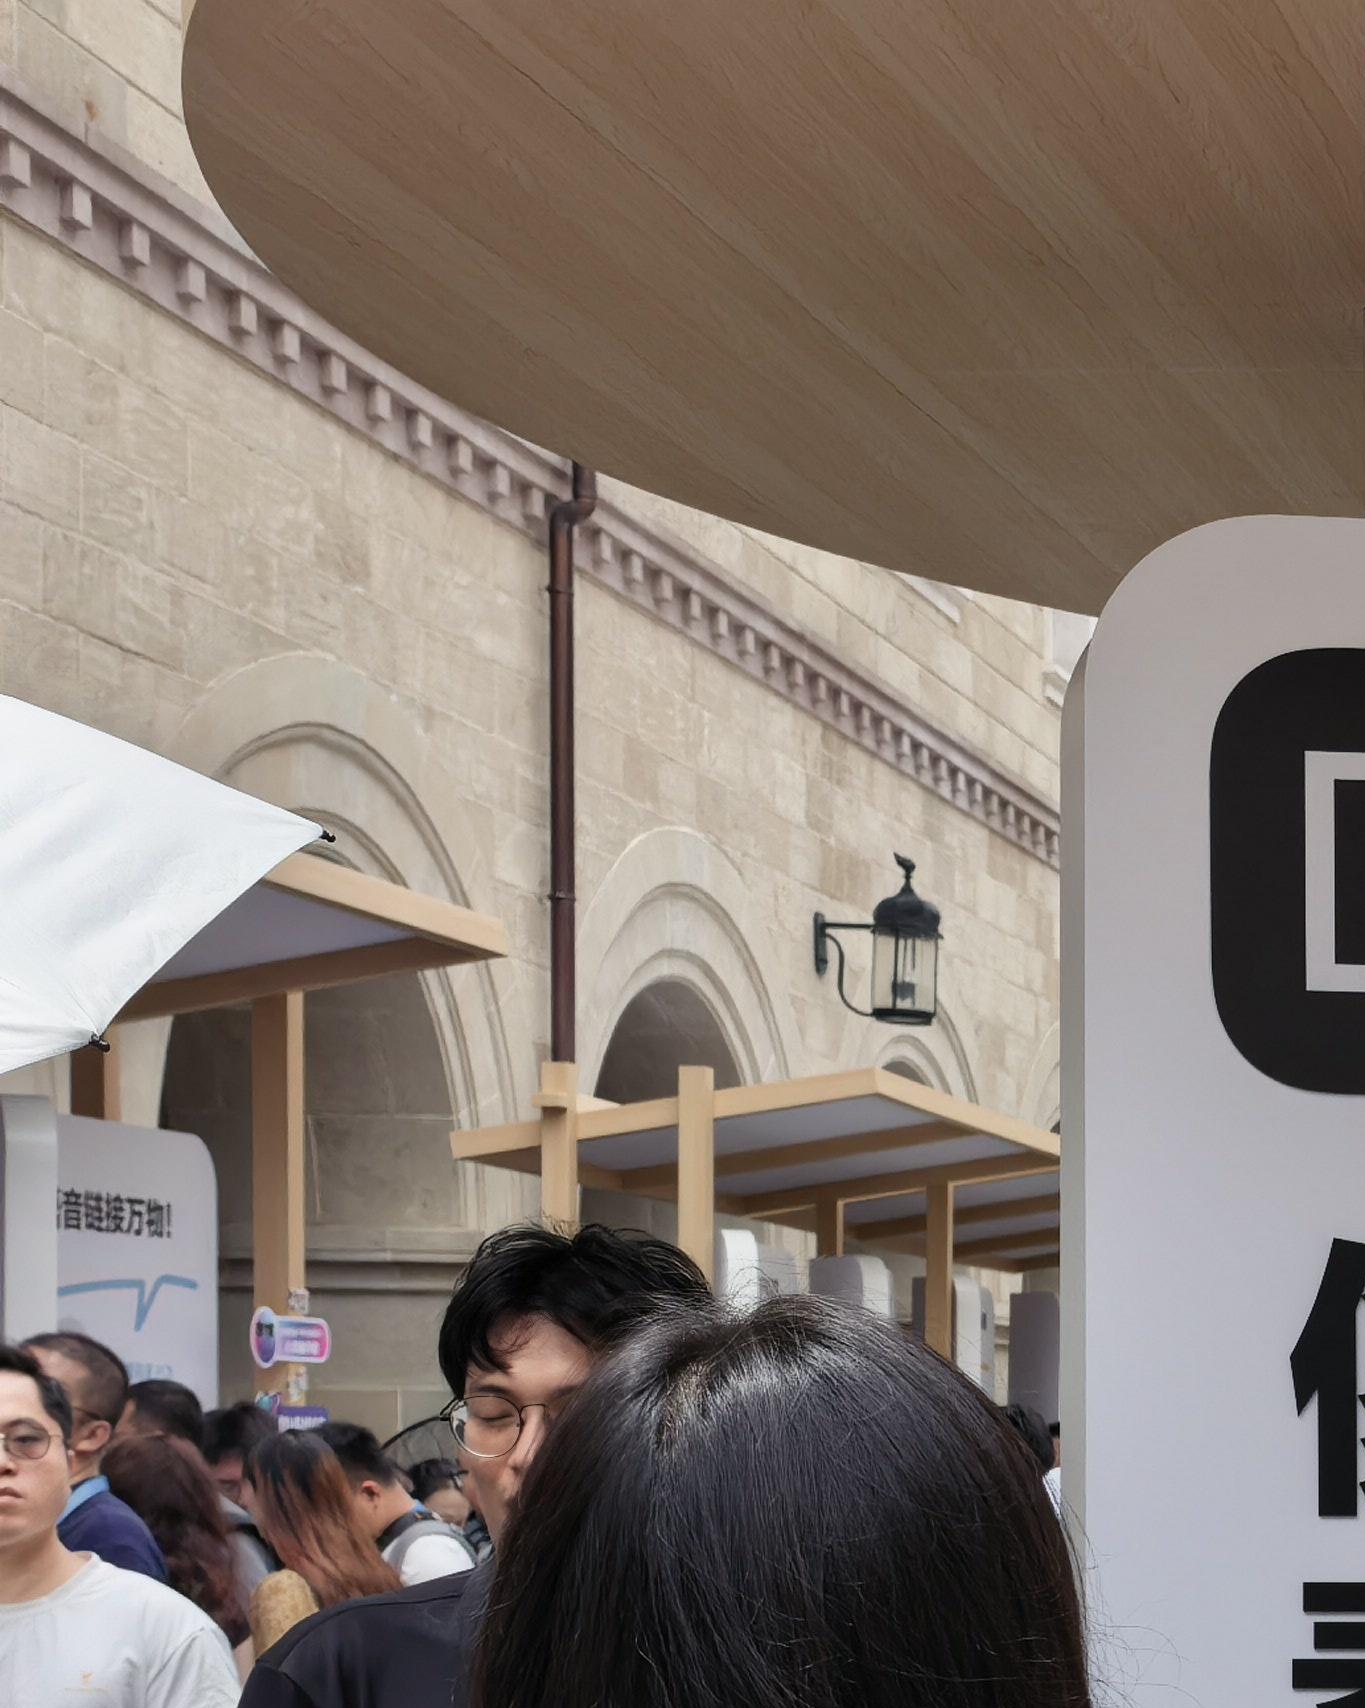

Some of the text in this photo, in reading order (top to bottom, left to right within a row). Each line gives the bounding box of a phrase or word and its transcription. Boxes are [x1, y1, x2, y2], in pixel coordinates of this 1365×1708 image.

[57, 1188, 171, 1239] 音链接万物！
